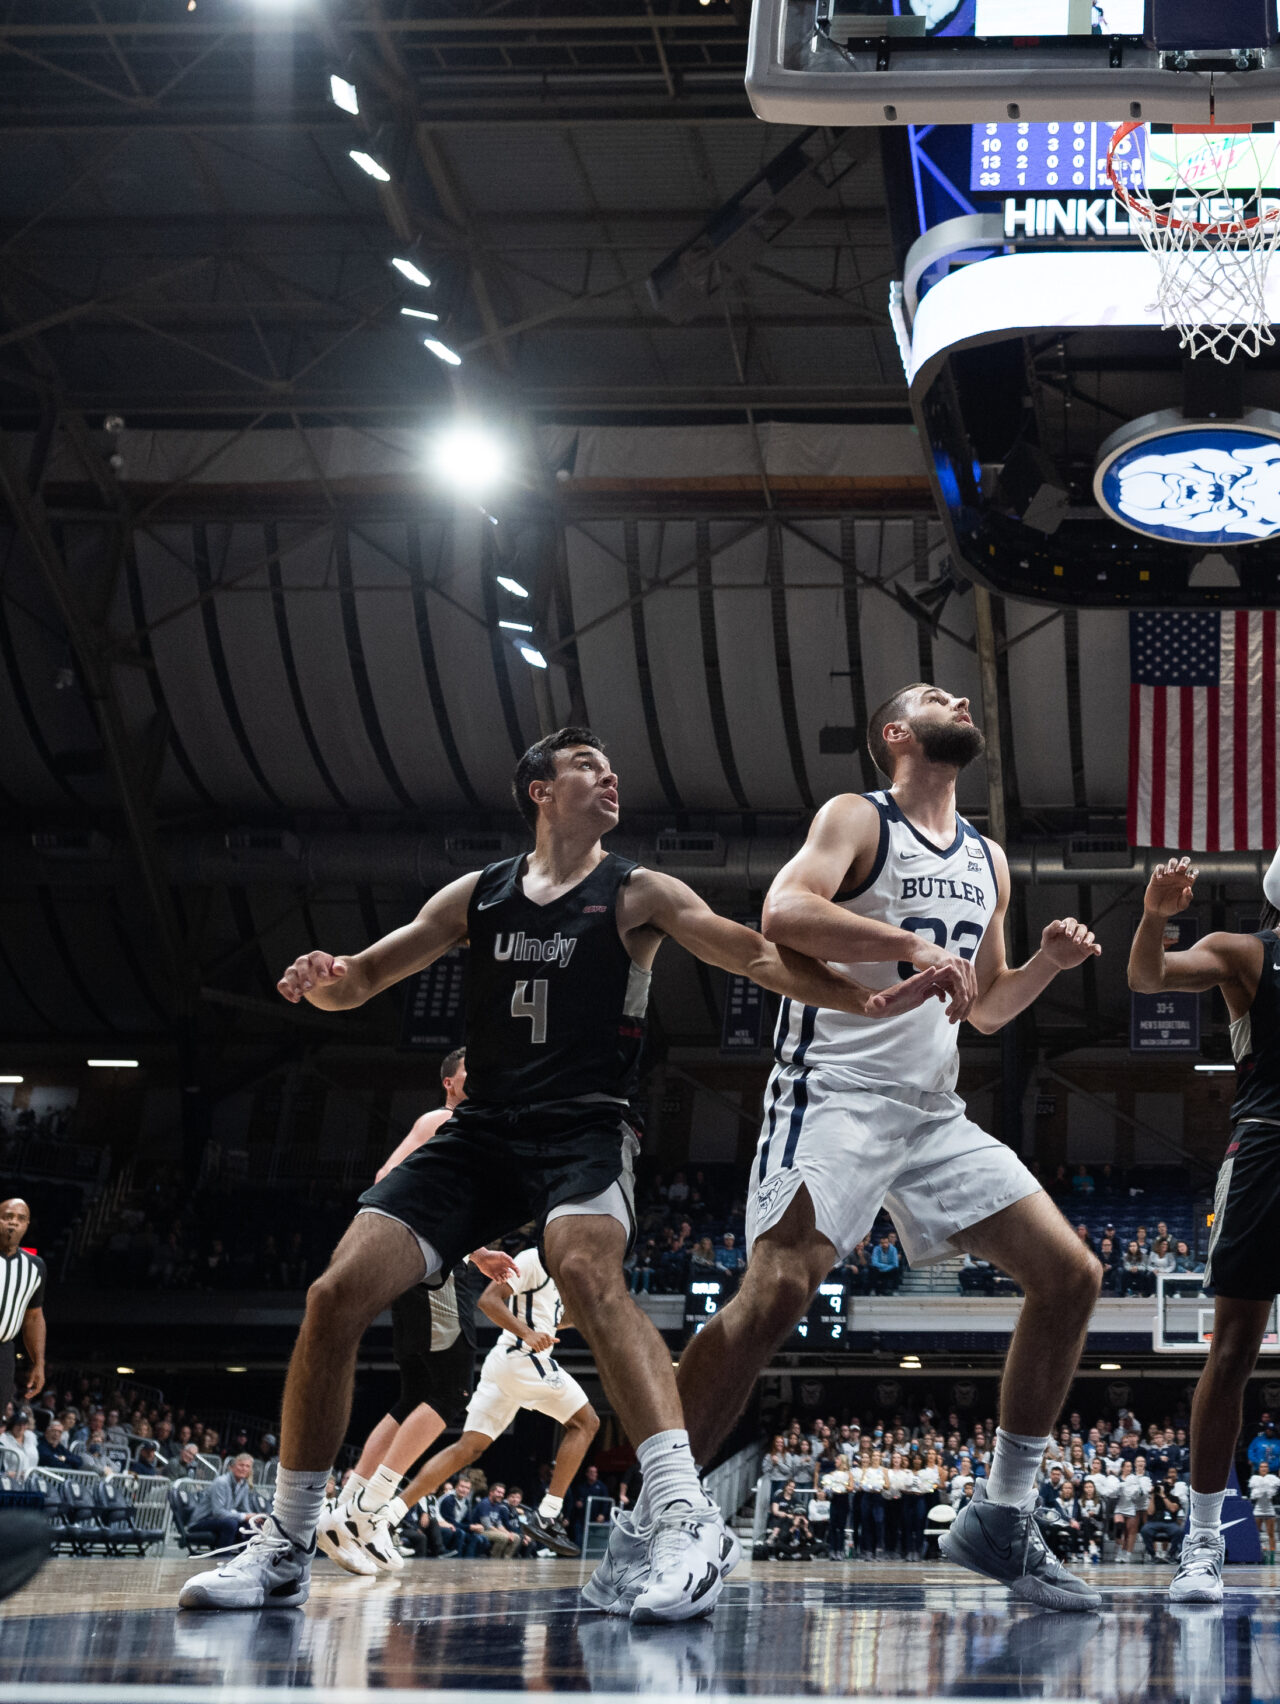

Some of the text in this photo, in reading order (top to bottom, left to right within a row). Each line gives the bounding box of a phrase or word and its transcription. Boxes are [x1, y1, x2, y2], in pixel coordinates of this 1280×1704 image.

[985, 122, 1085, 135] 3 3 0 0
[981, 138, 1085, 152] 10 0 3 0
[980, 154, 1084, 169] 13 2 0 0
[979, 171, 1084, 186] 33 1 0 0
[1004, 197, 1151, 237] HINKLE
[900, 876, 987, 911] BUTLER
[493, 931, 578, 969] UIndy
[510, 978, 548, 1044] 4
[705, 1296, 717, 1313] 6
[829, 1296, 842, 1314] 9
[798, 1324, 808, 1338] 4
[831, 1324, 842, 1339] 2
